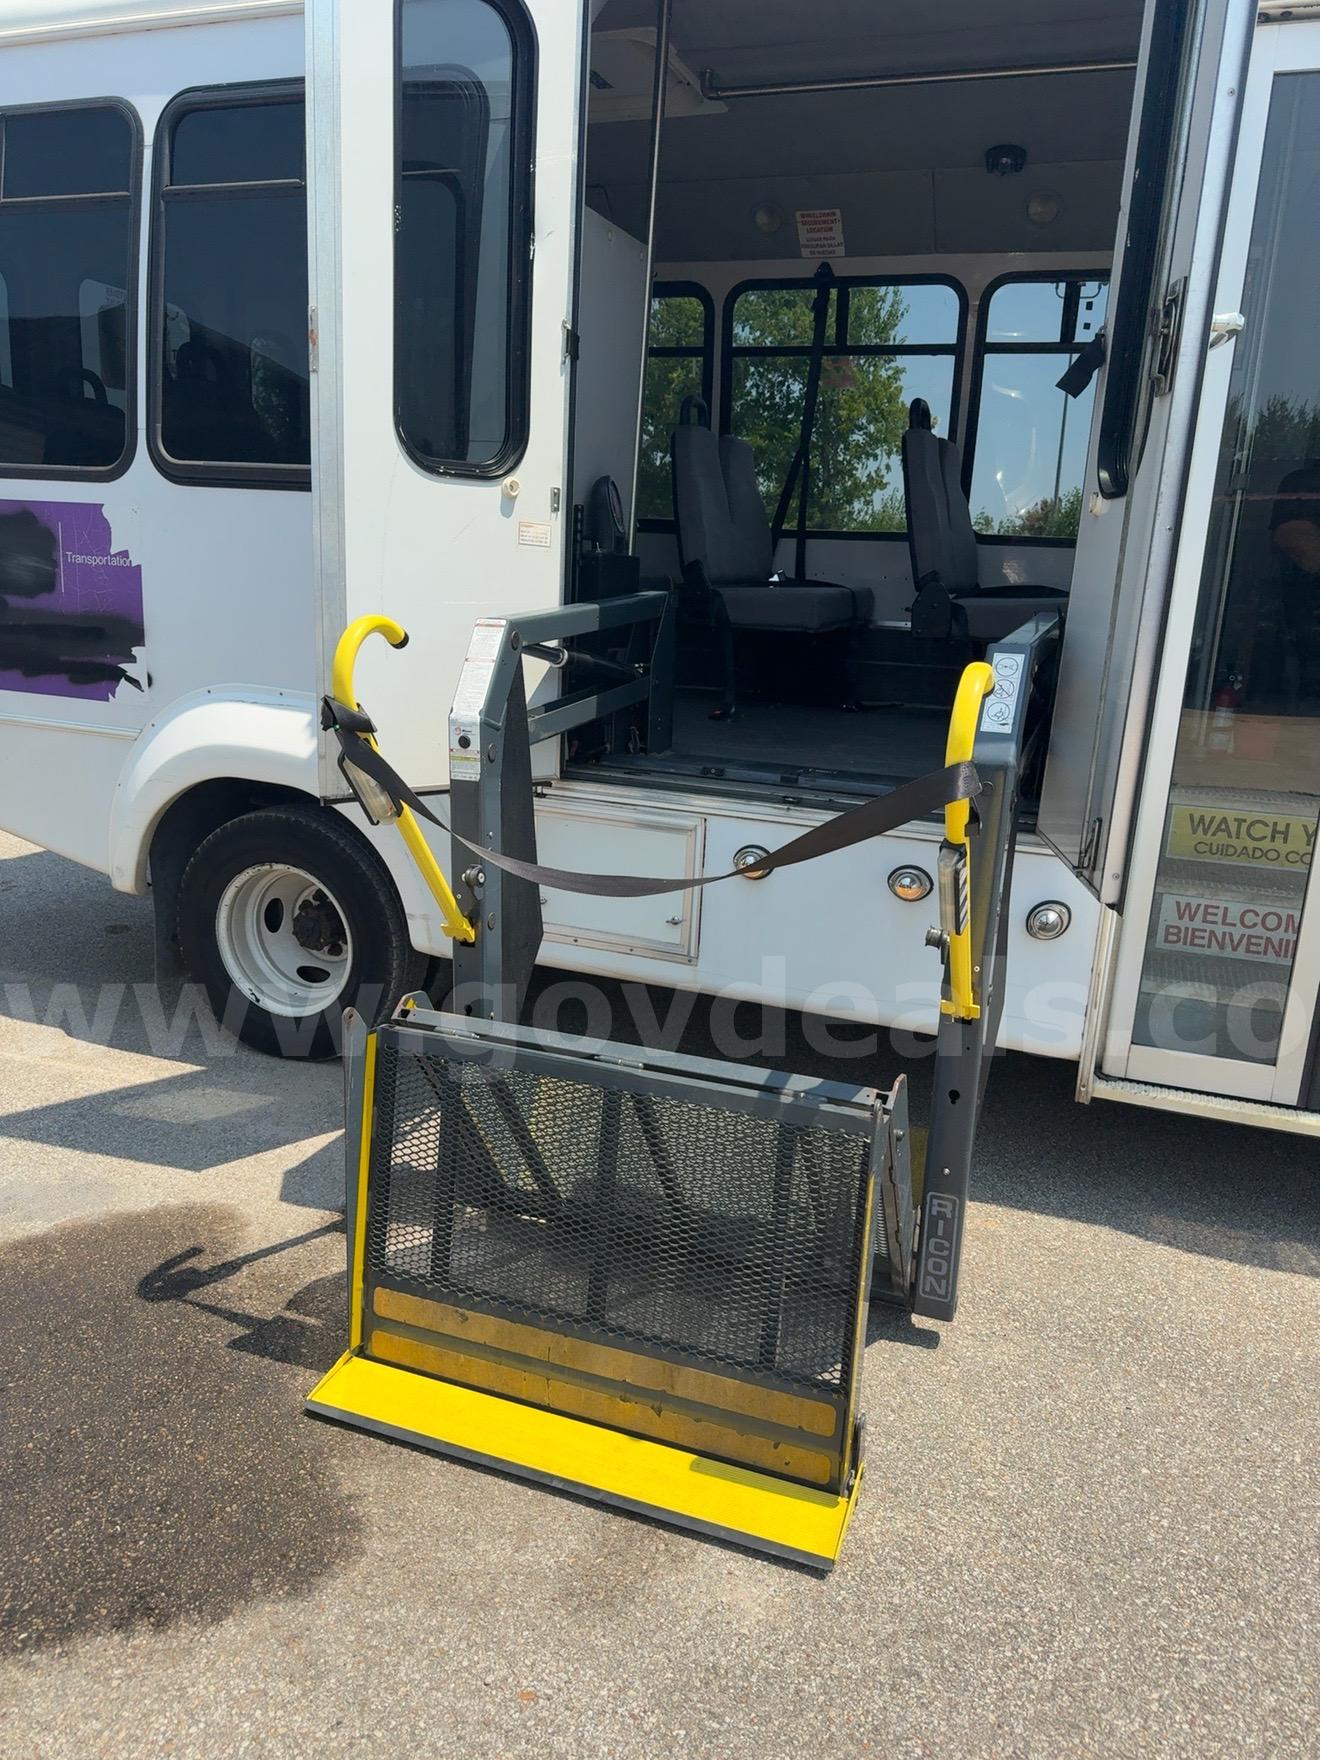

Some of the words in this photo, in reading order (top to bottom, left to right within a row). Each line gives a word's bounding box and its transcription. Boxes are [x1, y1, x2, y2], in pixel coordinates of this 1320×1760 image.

[66, 551, 133, 567] Transportation
[1189, 813, 1290, 844] WATCH
[1193, 841, 1280, 861] CUIDADO
[1163, 924, 1296, 959] BIENVENI
[924, 1199, 952, 1295] RICON
